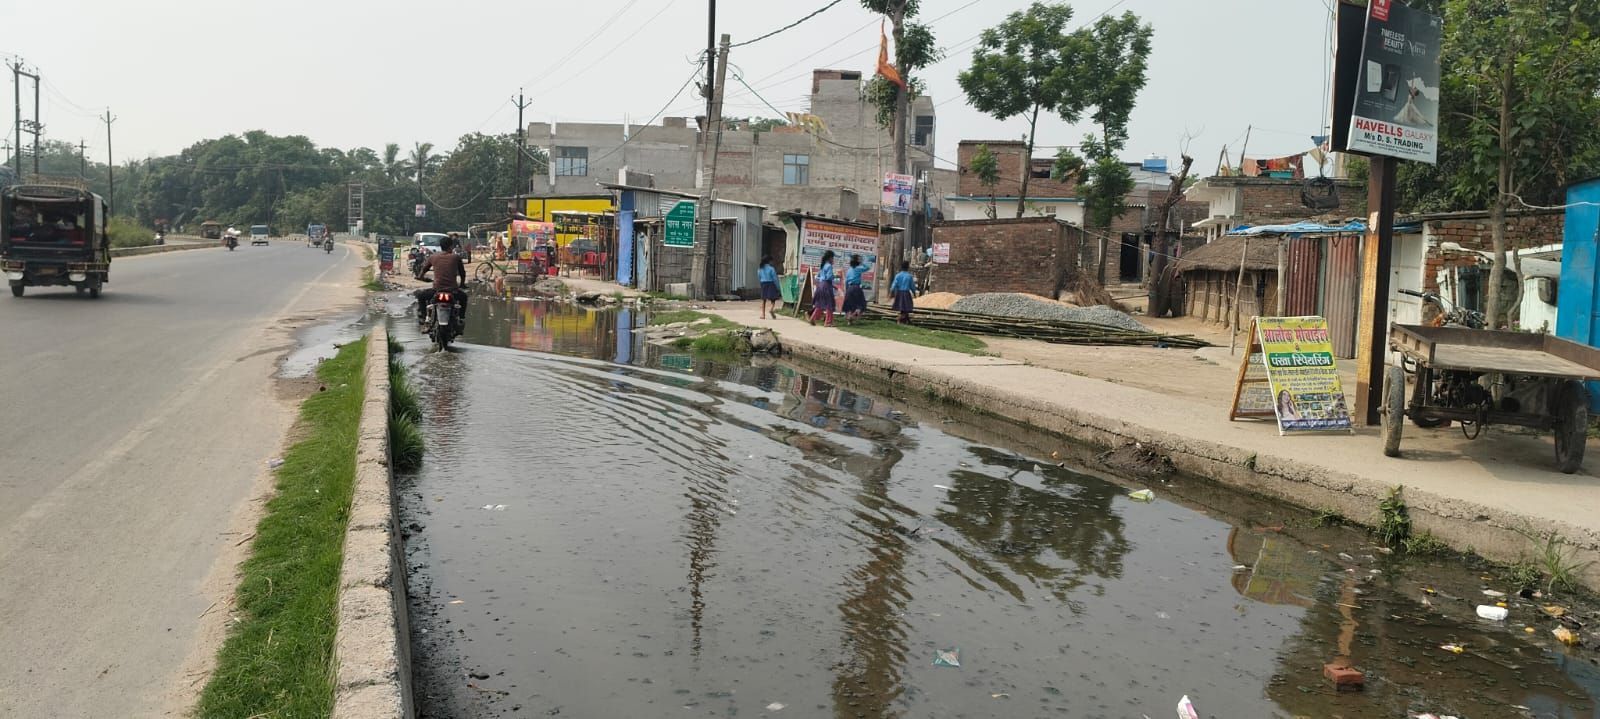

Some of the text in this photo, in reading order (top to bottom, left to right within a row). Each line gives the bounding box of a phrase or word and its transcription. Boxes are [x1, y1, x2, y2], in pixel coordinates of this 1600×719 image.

[1384, 37, 1404, 49] BEAUTY
[1355, 119, 1434, 142] HAVELLS GALAXY
[1394, 138, 1424, 150] TRADING
[681, 221, 693, 229] नगर
[1264, 325, 1294, 342] आलोक
[1271, 354, 1291, 366] पंखा
